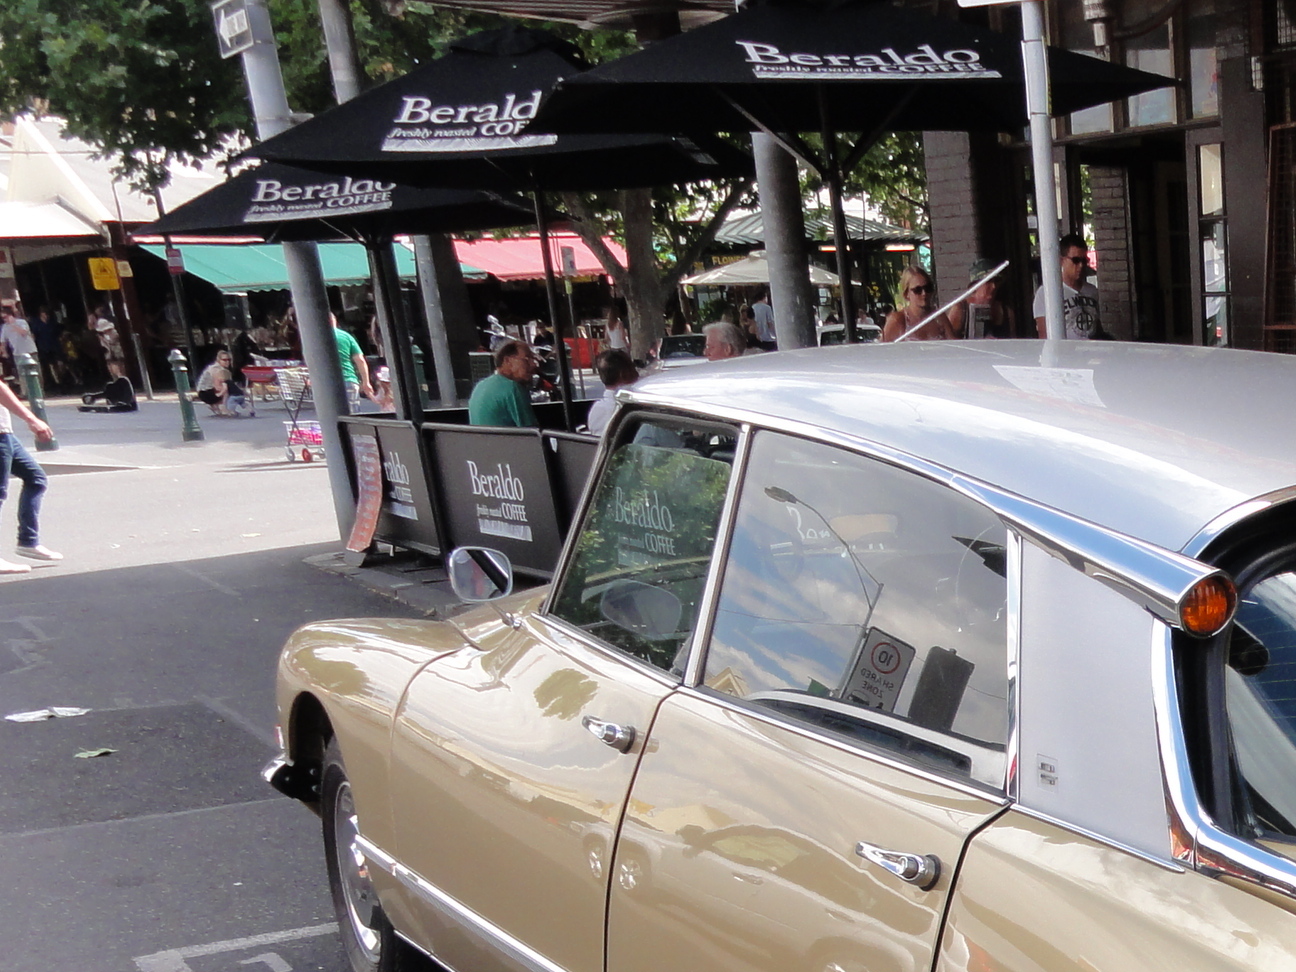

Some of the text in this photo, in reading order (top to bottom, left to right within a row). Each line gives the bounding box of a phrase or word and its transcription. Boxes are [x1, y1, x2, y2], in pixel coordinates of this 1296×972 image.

[735, 40, 981, 66] Beraldo
[879, 62, 988, 73] COFFEE
[389, 119, 531, 139] freshly roasted COF
[250, 204, 286, 214] freshly
[326, 191, 392, 209] COFFEE
[466, 460, 524, 502] Beraldo
[501, 502, 528, 522] COFFEE
[614, 486, 674, 533] Beraldo
[644, 532, 677, 556] COFFEE
